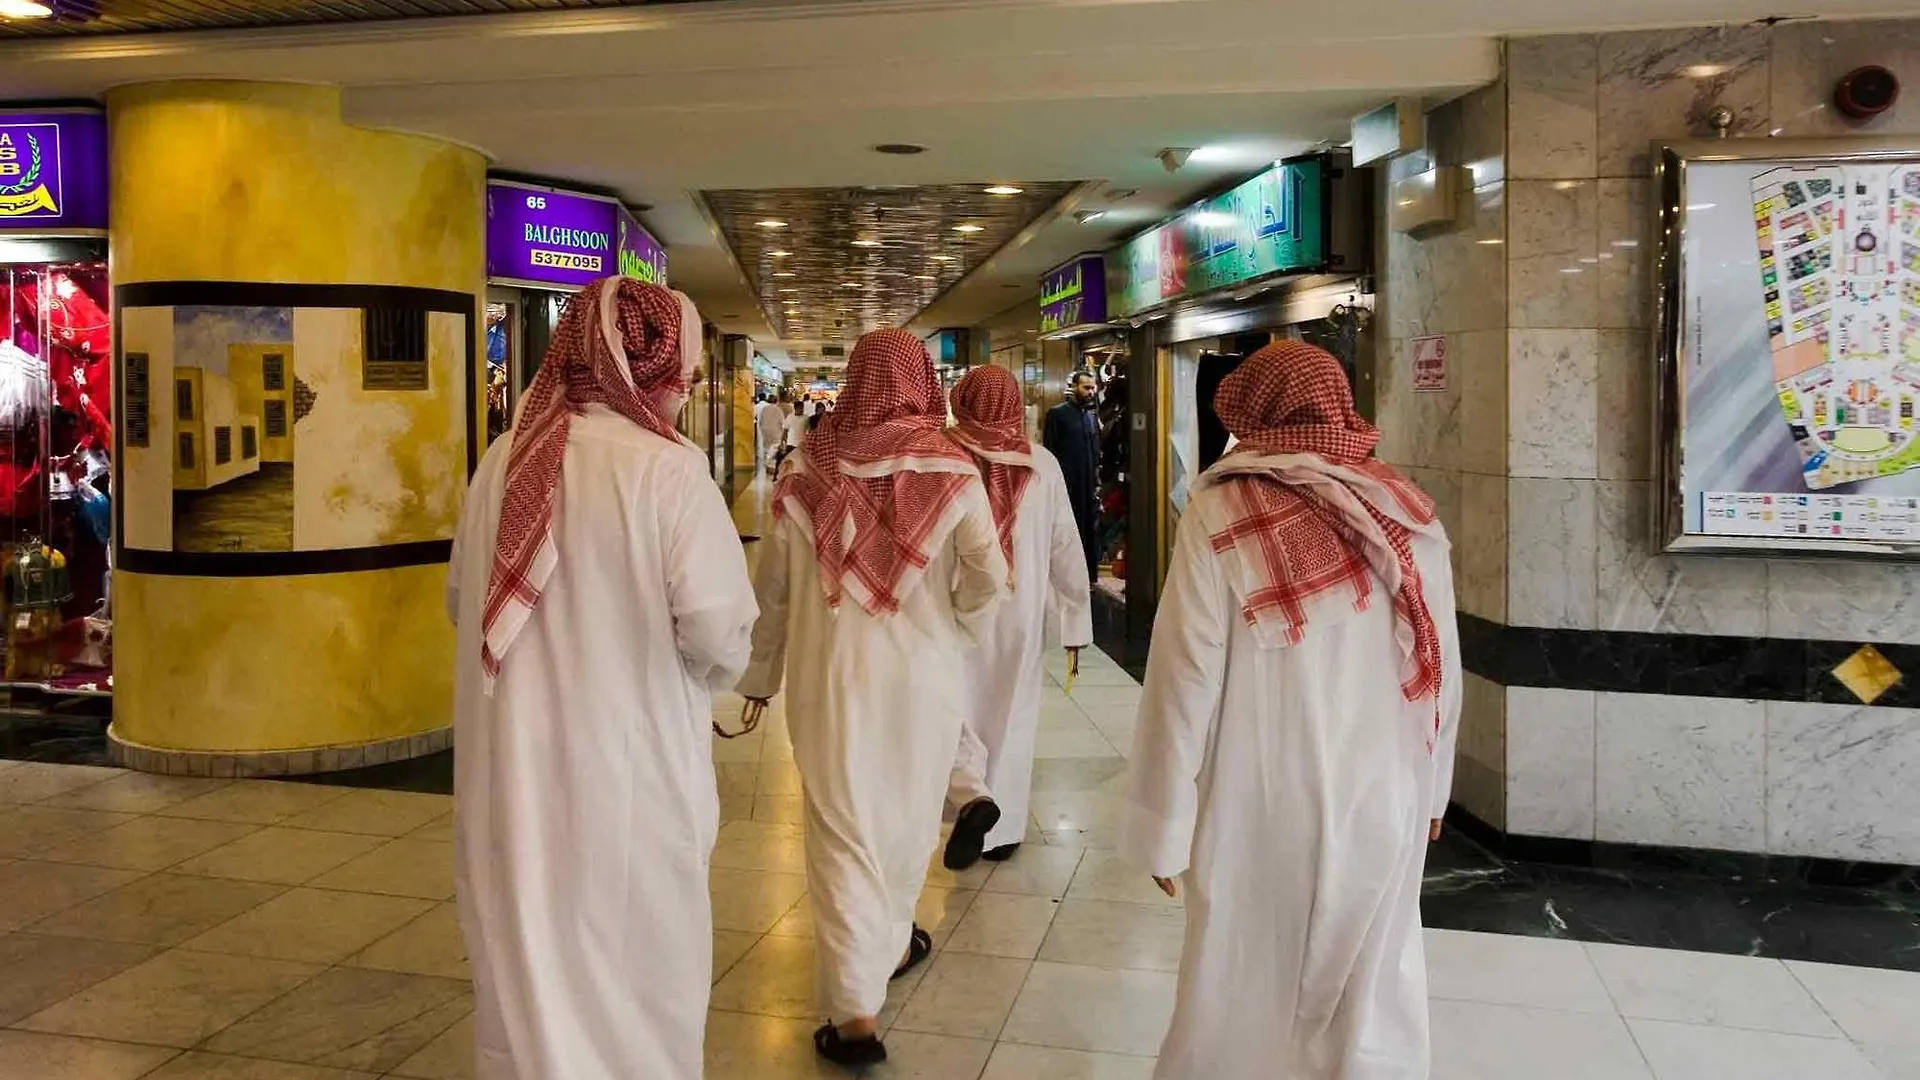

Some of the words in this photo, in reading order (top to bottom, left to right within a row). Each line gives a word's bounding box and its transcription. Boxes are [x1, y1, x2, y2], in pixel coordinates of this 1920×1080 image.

[0, 133, 12, 146] A
[526, 196, 547, 210] 65
[524, 222, 609, 251] BALGHSOON
[535, 251, 600, 269] 5377095
